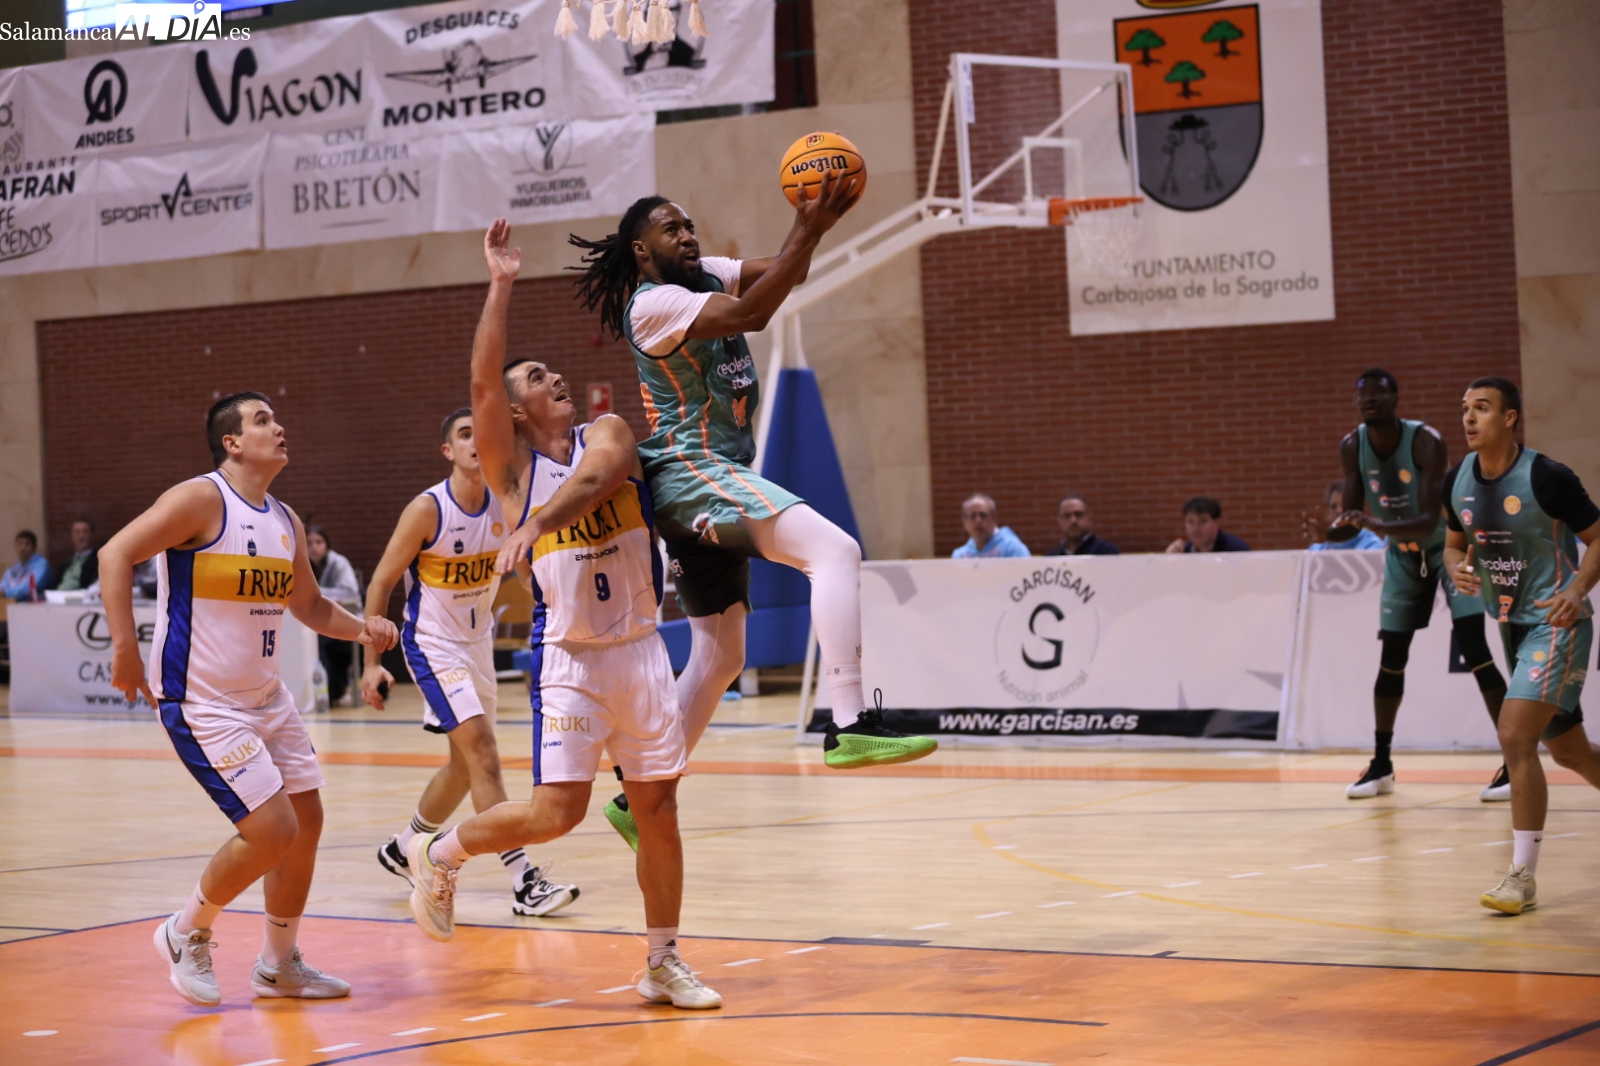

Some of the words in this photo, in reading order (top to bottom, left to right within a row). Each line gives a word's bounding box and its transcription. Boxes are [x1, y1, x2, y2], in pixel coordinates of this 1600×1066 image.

[405, 10, 521, 45] DESGUACES
[383, 87, 546, 127] MONTERO
[75, 127, 135, 149] ANDRÉS
[791, 155, 848, 175] Wilson
[294, 166, 421, 214] BRETÓN
[510, 190, 592, 209] INMOBILIARIA
[516, 176, 587, 194] YUGUEROS
[1124, 250, 1275, 279] YUNTAMIENTO
[1082, 284, 1177, 306] Carbajosa
[1183, 280, 1206, 299] de
[1213, 277, 1231, 296] la
[1236, 270, 1320, 298] Sagrada
[237, 568, 293, 600] IRUK
[594, 572, 611, 602] 9
[1010, 567, 1095, 604] GARCISAN
[262, 630, 276, 657] 15
[544, 716, 591, 733] IRUKI
[939, 709, 1139, 734] www.garcisan.es
